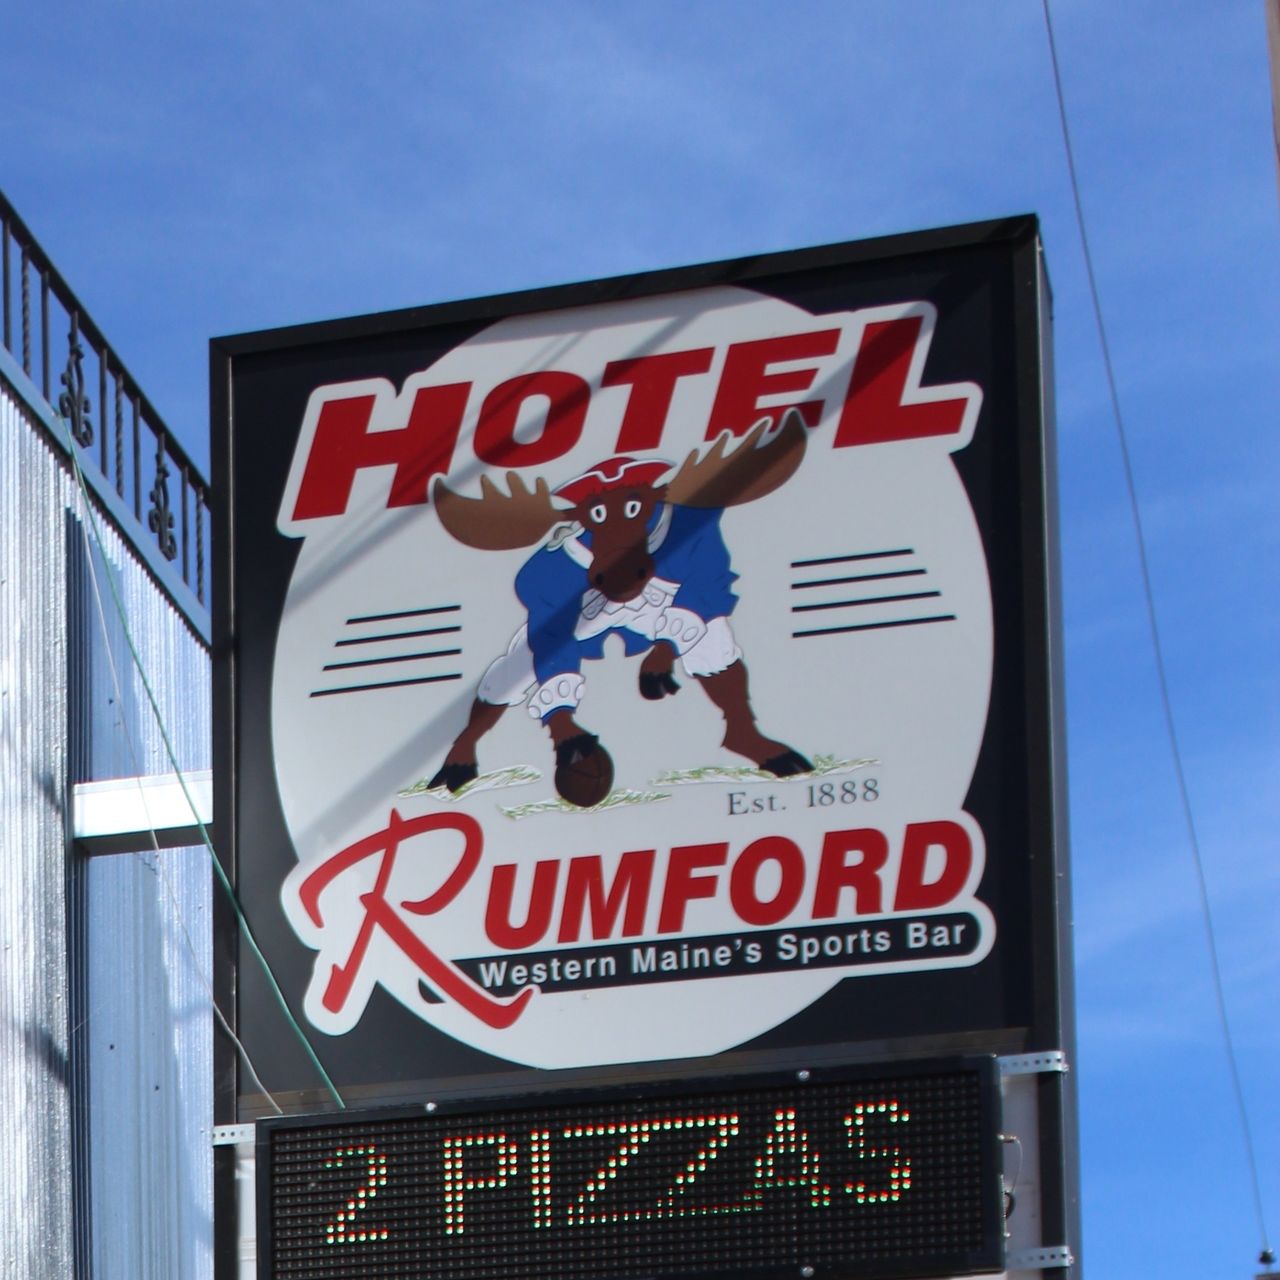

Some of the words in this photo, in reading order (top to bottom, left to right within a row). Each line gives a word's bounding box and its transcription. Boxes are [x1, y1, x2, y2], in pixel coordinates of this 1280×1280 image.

[291, 316, 970, 521] HOTEL
[726, 790, 787, 816] Est.
[807, 778, 880, 808] 1888
[299, 809, 974, 1030] RUMFORD
[478, 953, 617, 990] Western
[631, 938, 762, 975] Maine's
[777, 929, 892, 965] Sports
[906, 920, 966, 949] Bar
[325, 1145, 388, 1245] 2
[443, 1101, 911, 1235] PIZZAS
